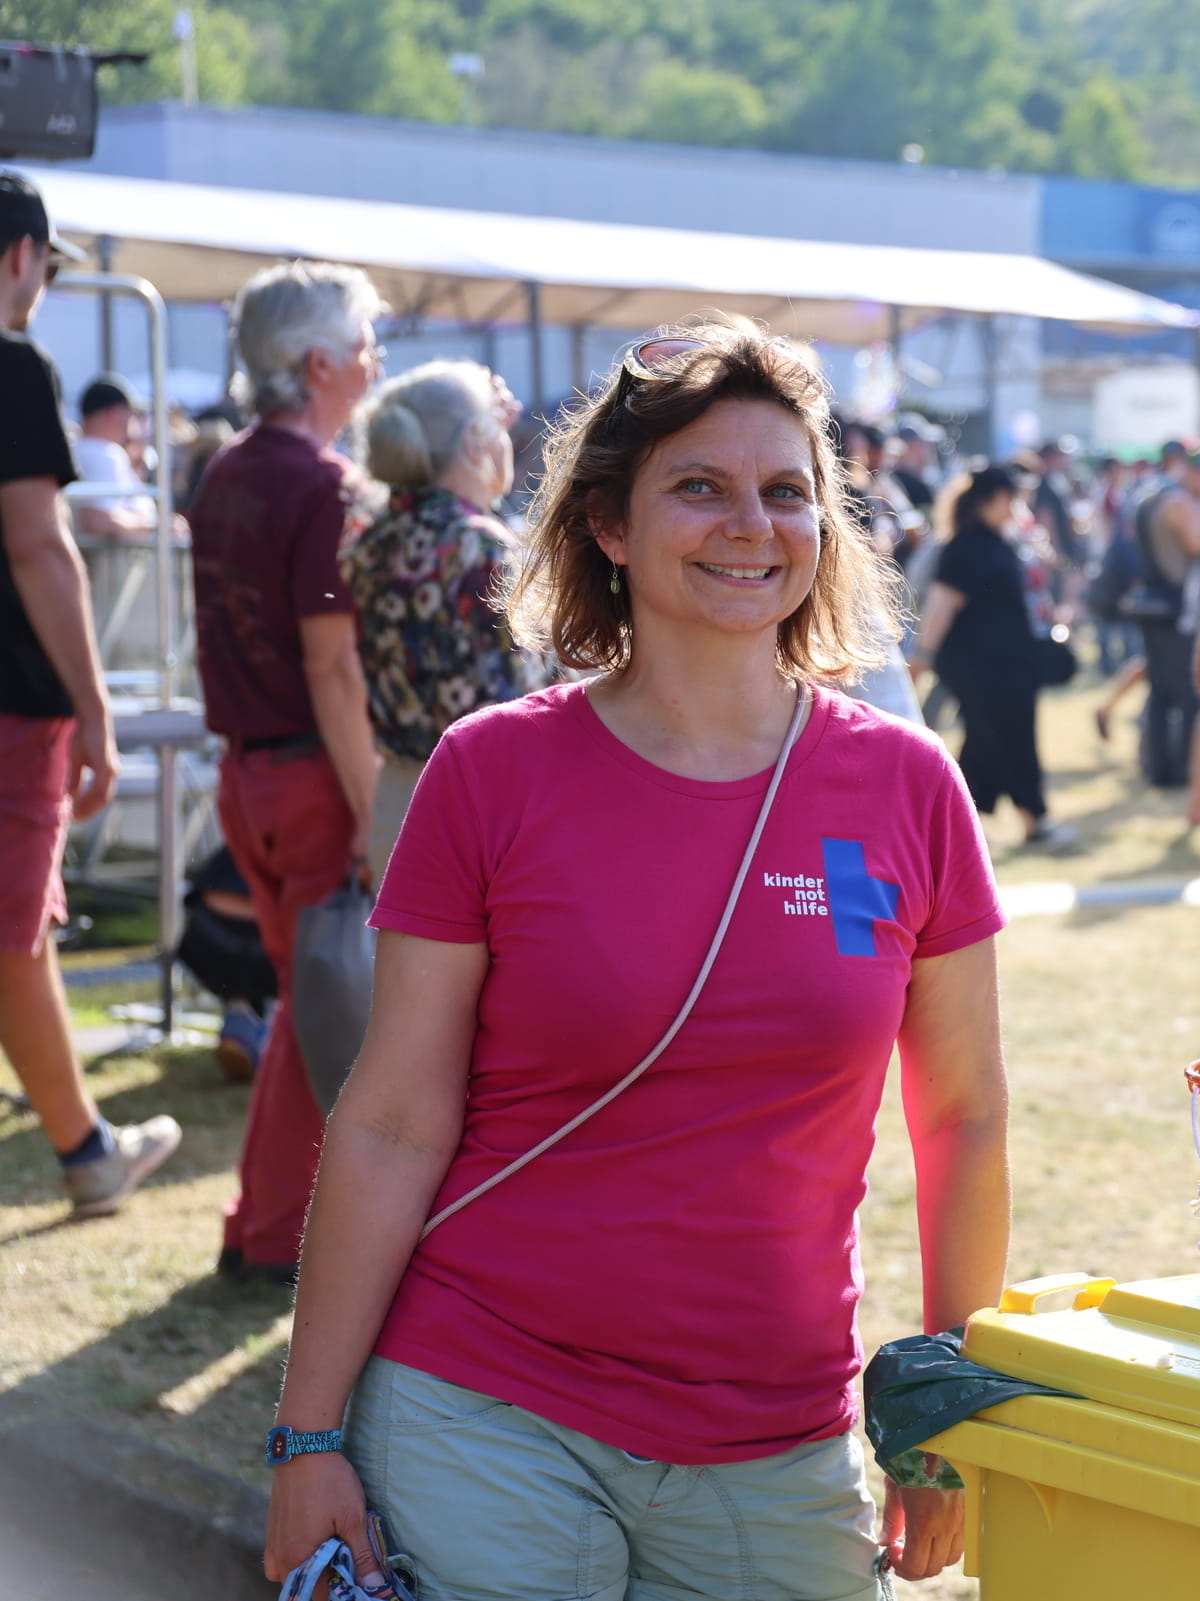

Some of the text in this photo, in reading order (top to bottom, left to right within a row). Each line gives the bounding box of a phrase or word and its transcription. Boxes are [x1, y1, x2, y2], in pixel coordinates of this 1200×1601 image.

[763, 872, 824, 888] kinder
[795, 889, 826, 902] not
[783, 901, 829, 916] hilfe
